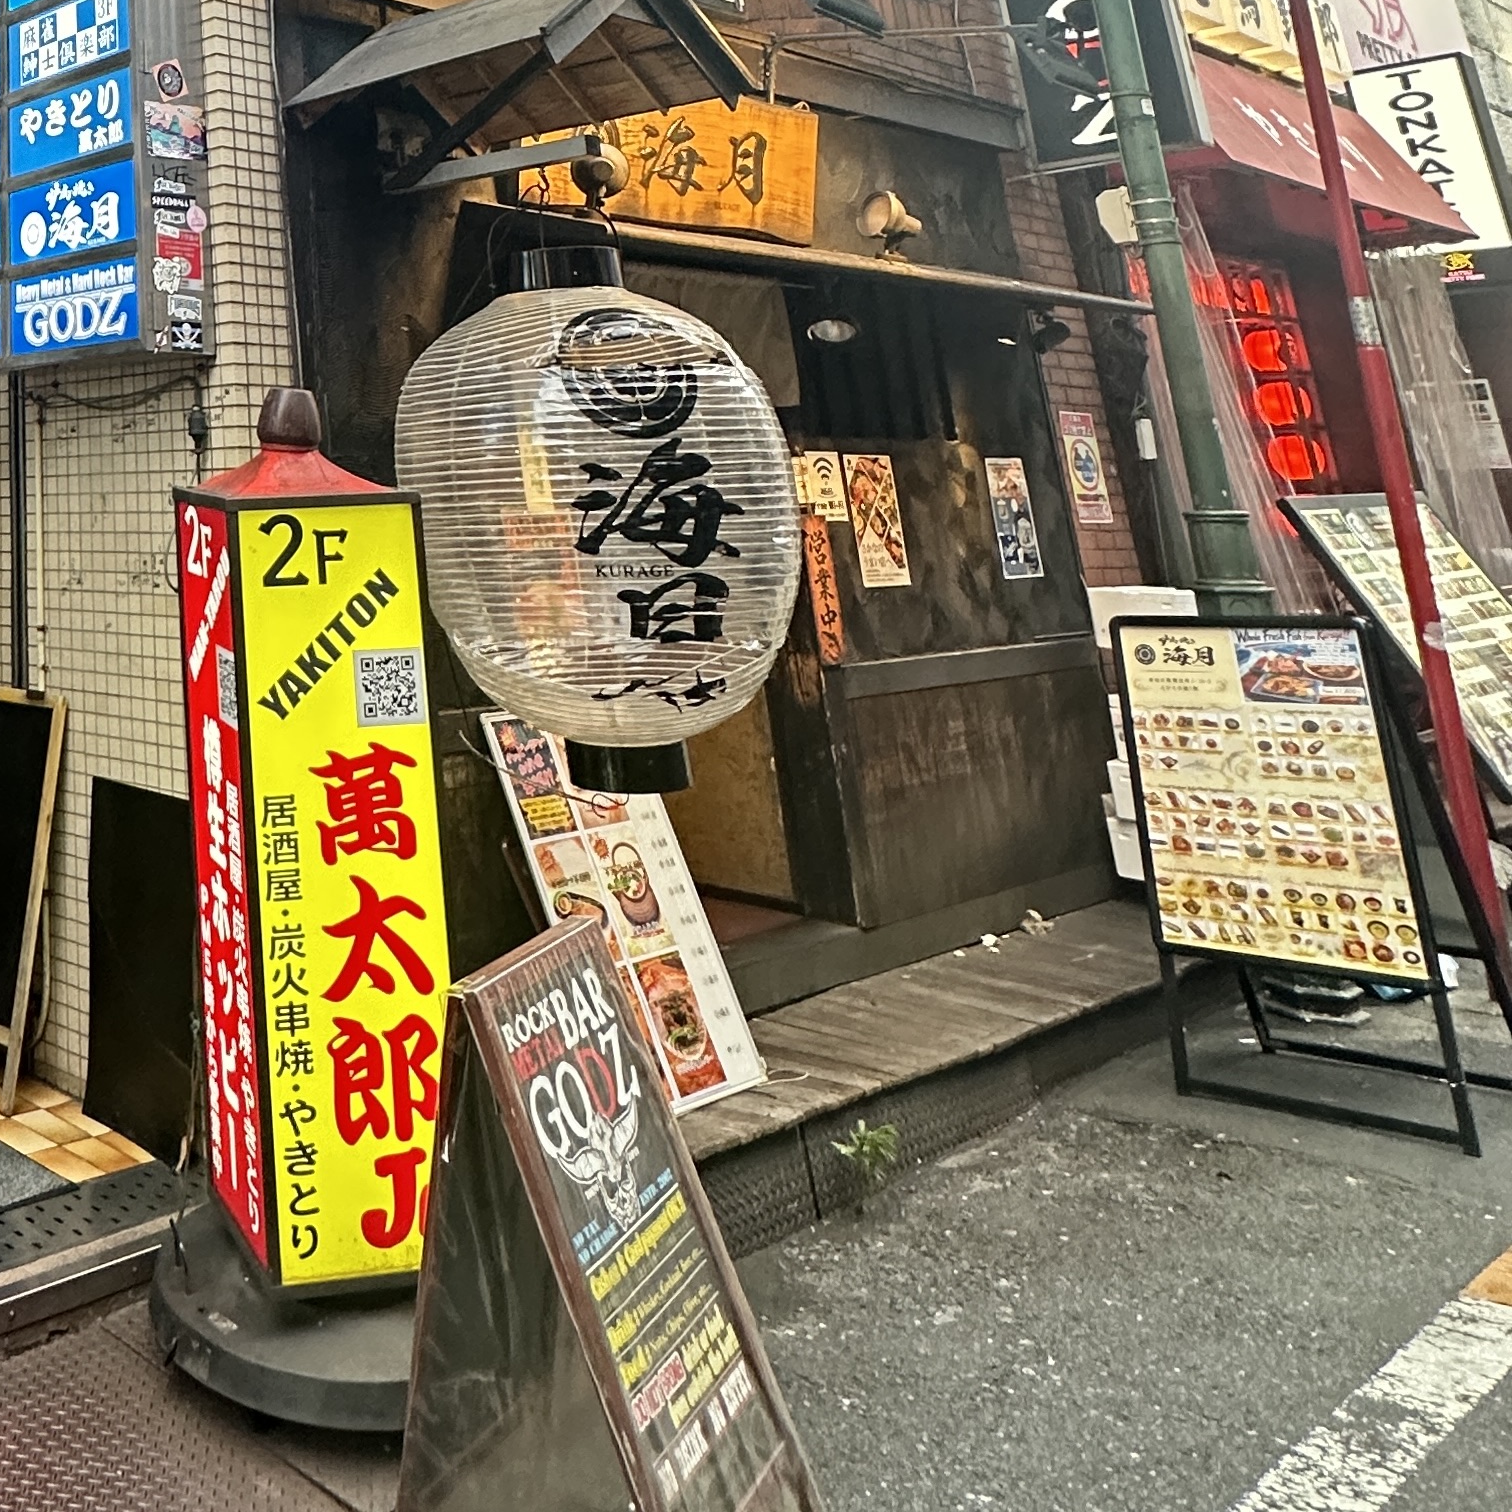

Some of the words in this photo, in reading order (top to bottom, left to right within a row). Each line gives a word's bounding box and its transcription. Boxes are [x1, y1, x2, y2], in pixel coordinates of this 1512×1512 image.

[23, 12, 56, 51] 麻雀
[1356, 30, 1403, 64] PRETTY
[20, 79, 120, 145] やきとり
[639, 115, 768, 205] 海月
[48, 191, 120, 250] 海月
[15, 282, 40, 304] Heavy
[40, 277, 64, 299] Metal
[65, 277, 71, 291] &
[72, 272, 93, 294] Hard
[94, 266, 117, 288] Rock
[117, 264, 134, 284] Bar
[23, 288, 127, 347] GODZ
[184, 505, 213, 579] 2F
[258, 513, 349, 588] 2F
[595, 564, 675, 579] KURAGE
[571, 437, 746, 713] 海月
[807, 531, 840, 629] 営業中
[257, 568, 400, 722] YAKITON
[1163, 646, 1215, 667] 海月
[1263, 629, 1285, 643] Fresh
[1286, 629, 1302, 642] Fish
[202, 712, 240, 1192] 樽生ホッピー
[308, 742, 440, 1149] 萬太郎
[501, 998, 557, 1054] ROCK
[549, 967, 615, 1051] BAR
[510, 1036, 566, 1083] METAL
[528, 1023, 642, 1159] GODZ
[624, 1232, 645, 1267] Card
[705, 1303, 724, 1342] food
[619, 1345, 649, 1390] Food
